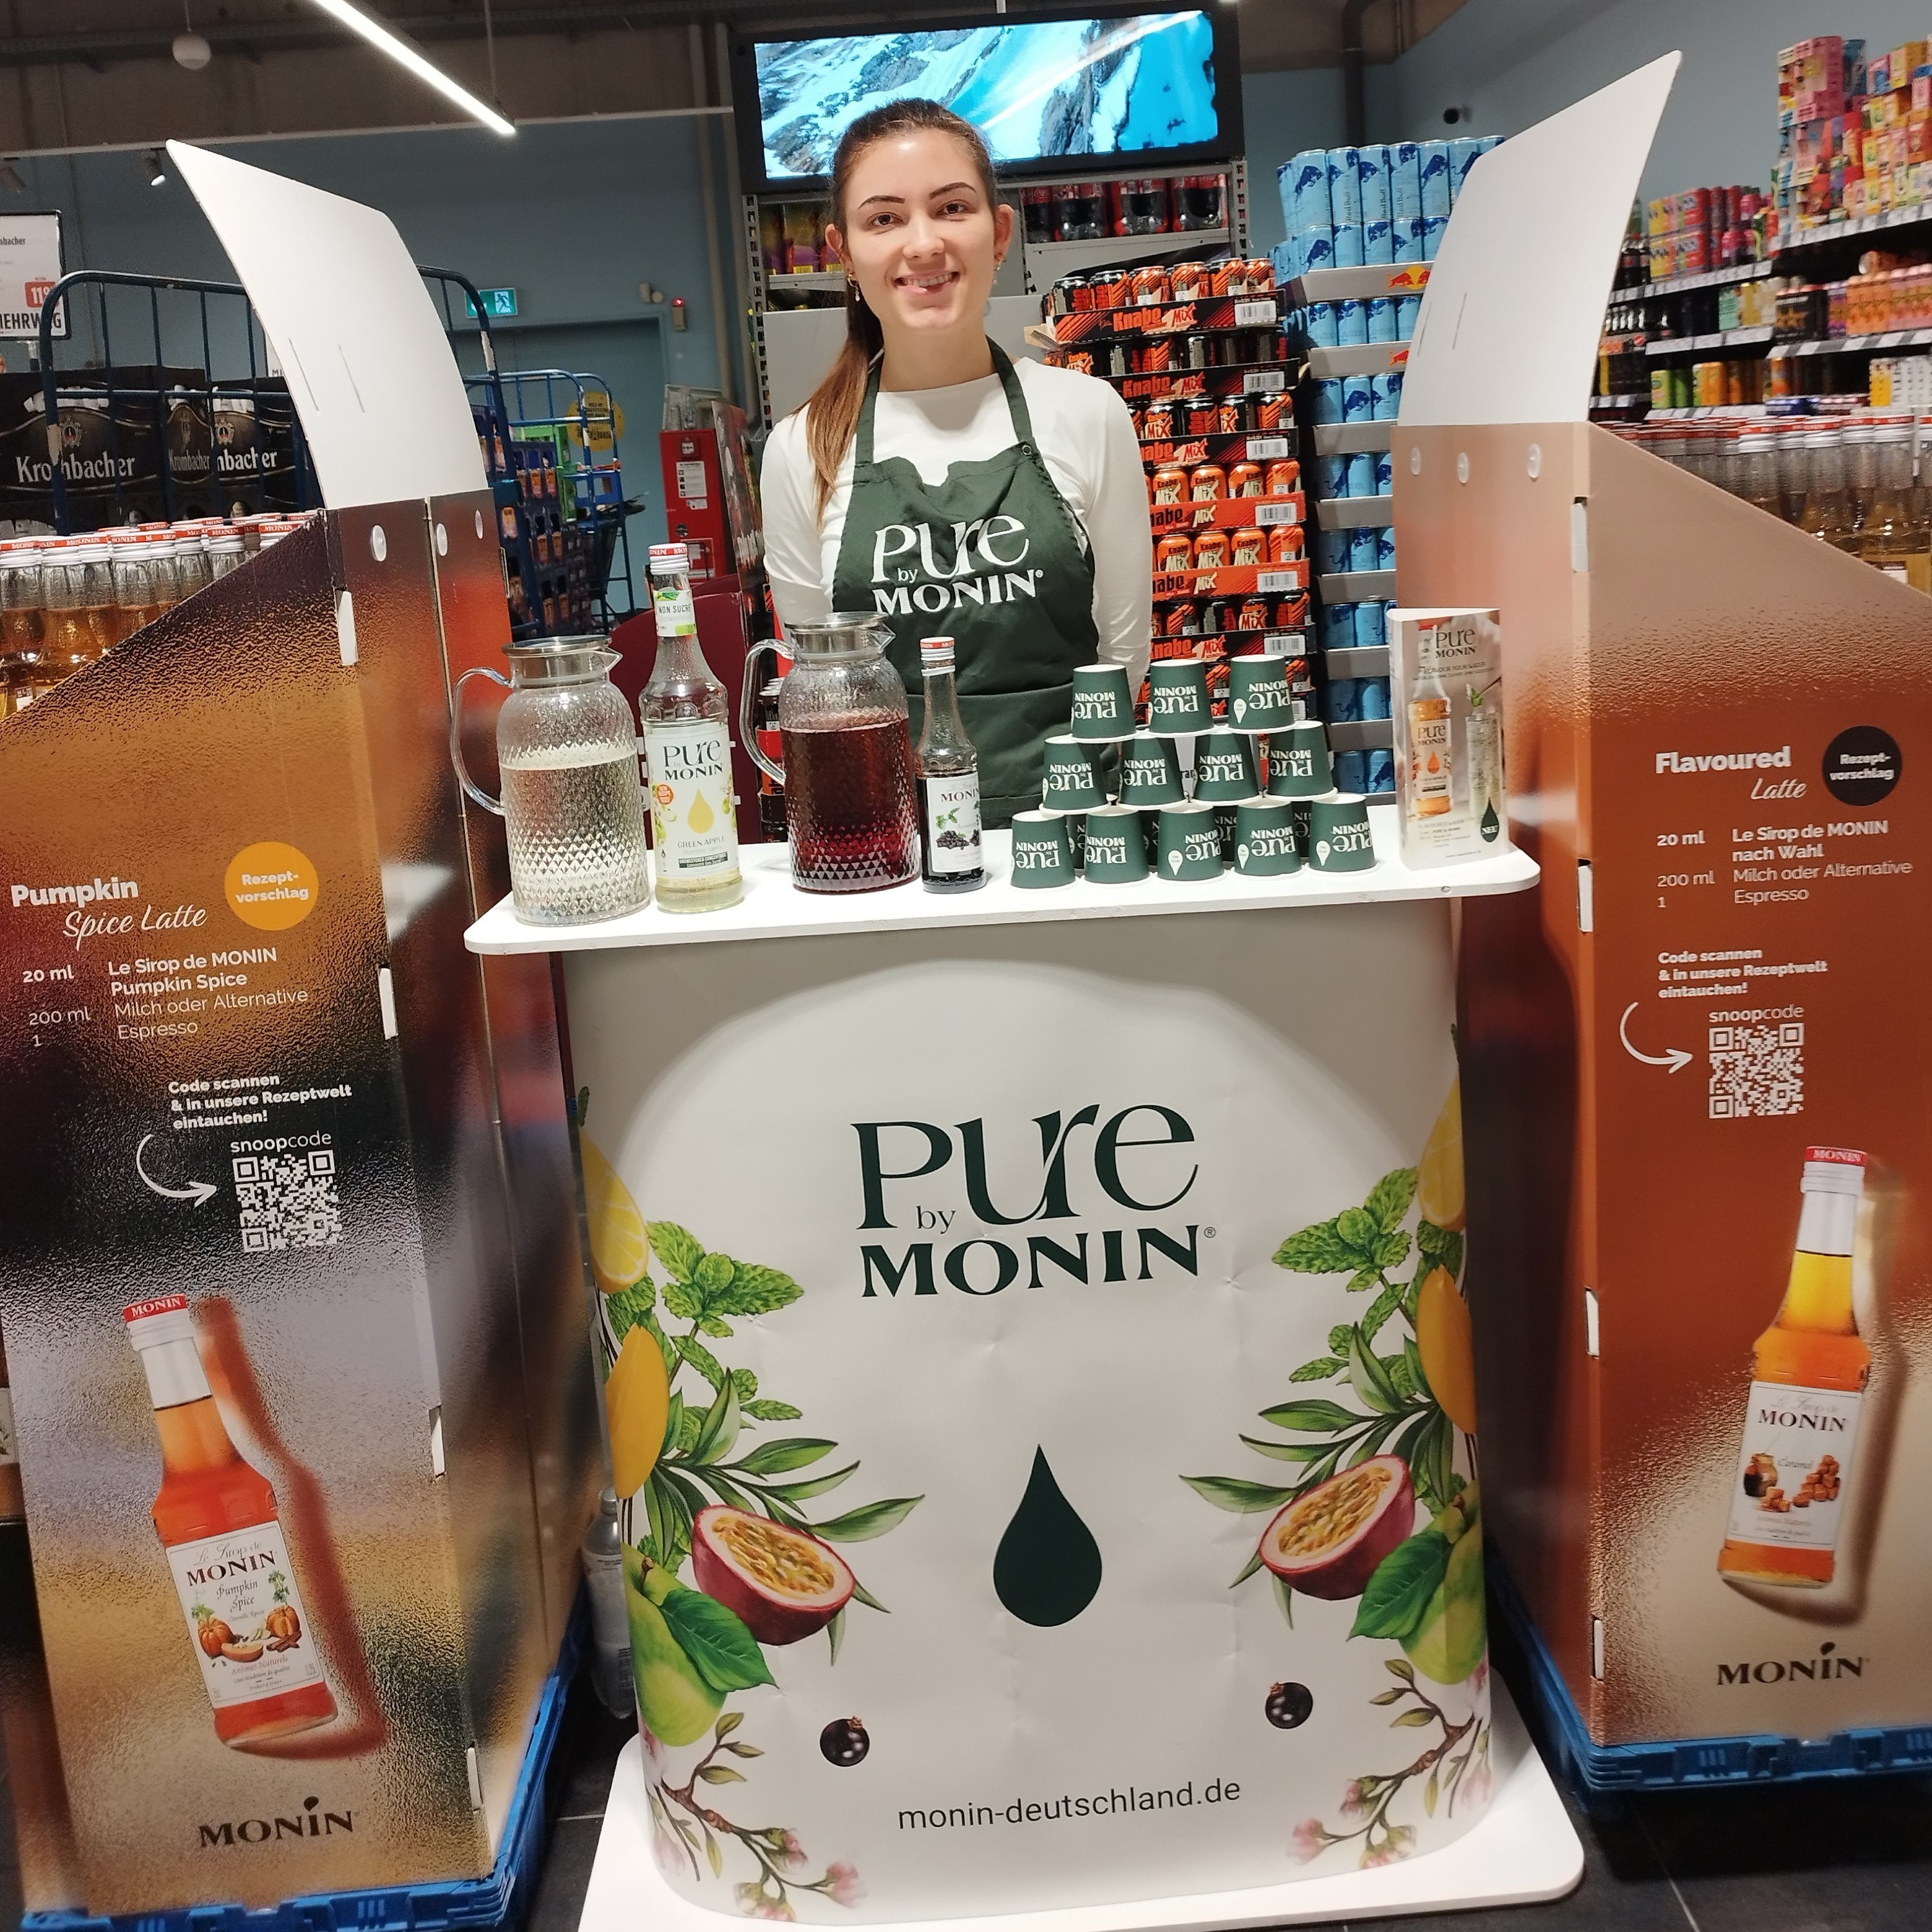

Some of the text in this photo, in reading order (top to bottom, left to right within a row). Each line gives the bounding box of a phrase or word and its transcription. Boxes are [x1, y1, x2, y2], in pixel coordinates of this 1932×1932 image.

[0, 311, 62, 330] EHRWG
[1113, 307, 1162, 332] Knabe
[1122, 375, 1171, 399] Knabe
[1141, 440, 1174, 462] nabe
[870, 515, 1030, 583] Pure
[898, 567, 918, 583] by
[1436, 629, 1475, 649] Pure
[1435, 647, 1475, 658] MONIN
[1074, 691, 1116, 702] MONIN
[1153, 685, 1197, 696] MONIN
[1249, 689, 1291, 709] Pure
[1075, 701, 1118, 719] Pure
[1153, 695, 1199, 714] Pure
[1418, 724, 1446, 739] Pure
[663, 740, 721, 767] Pure
[1199, 753, 1242, 764] MONIN
[1271, 750, 1312, 759] MONIN
[1656, 746, 1792, 773] Flavoured
[1840, 753, 1891, 766] Rezept-
[665, 762, 723, 781] MONIN
[1049, 762, 1092, 773] MONIN
[1124, 759, 1166, 768] MONIN
[1199, 764, 1244, 782] Pure
[1270, 759, 1314, 777] Pure
[1050, 772, 1094, 791] Pure
[1124, 768, 1168, 786] Pure
[1830, 768, 1895, 781] vorschlag
[1751, 777, 1808, 800] Latte
[1086, 836, 1126, 846] MONIN
[1250, 826, 1293, 839] MONIN
[1332, 830, 1372, 851] Pure
[1657, 830, 1705, 846] 20 ml
[1732, 820, 1888, 843] Le Sirop de MONIN
[677, 840, 703, 849] GREEN
[1016, 840, 1058, 851] MONIN
[1185, 838, 1222, 861] Pure
[1251, 835, 1296, 857] Pure
[1732, 844, 1824, 862] nach Wahl
[1016, 850, 1060, 869] Pure
[1086, 846, 1127, 864] Pure
[242, 871, 299, 886] Rezept-
[1657, 871, 1715, 887] 200 ml
[1733, 860, 1913, 882] Milch oder Alternative
[10, 877, 139, 907] Pumpkin
[236, 886, 309, 904] vorschlag
[1734, 888, 1810, 905] Espresso
[1658, 896, 1667, 908] 1
[62, 904, 208, 951] Spice Latte
[109, 947, 277, 977] Le Sirop de MONIN
[1658, 949, 1763, 964] Code scannen
[23, 965, 74, 983] 20 ml
[1658, 960, 1828, 981] & in unsere Rezeptwelt
[111, 972, 248, 999] Pumpkin Spice
[1658, 982, 1748, 998] eintauchen!
[115, 989, 309, 1019] Milch oder Alternative
[1709, 1004, 1804, 1023] snoopcode
[29, 1006, 91, 1026] 200 ml
[32, 1034, 42, 1047] 1
[118, 1021, 198, 1043] Espresso
[168, 1075, 280, 1094] Code scannen
[171, 1084, 352, 1112] & in unsere Rezeptwelt
[173, 1110, 268, 1130] eintauchen!
[230, 1130, 332, 1153] snoopcode
[1814, 1149, 1861, 1162] MONIN
[850, 1104, 1199, 1229] Pure
[916, 1205, 956, 1235] by
[131, 1296, 181, 1318] MONIN
[1758, 1408, 1846, 1432] MONIN
[186, 1550, 276, 1587] MONIN
[216, 1580, 258, 1600] Pumpkin
[230, 1595, 255, 1613] Spice
[1717, 1642, 1863, 1685] MONIN
[898, 1777, 1241, 1830] monin-deutschland.de
[199, 1795, 354, 1848] MONIN
